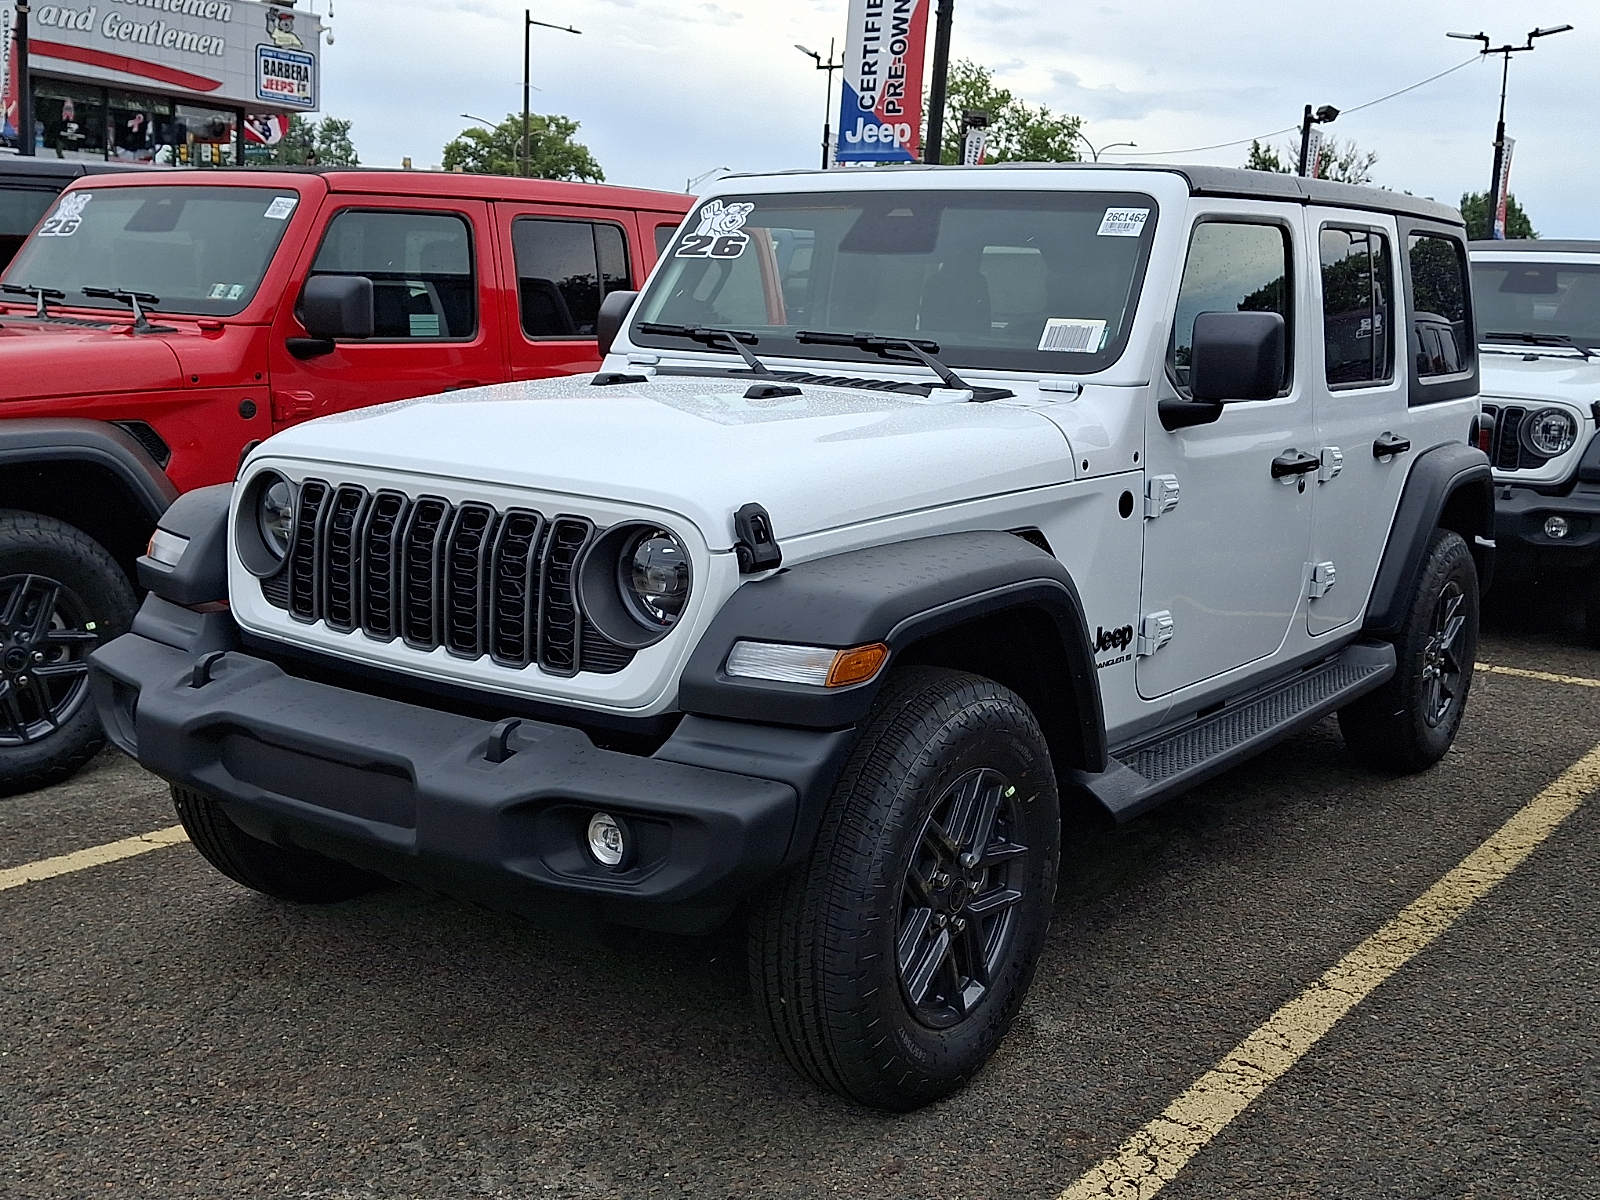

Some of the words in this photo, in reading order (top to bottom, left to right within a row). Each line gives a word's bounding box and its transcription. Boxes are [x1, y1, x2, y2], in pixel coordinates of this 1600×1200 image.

[37, 4, 97, 32] and
[102, 11, 226, 56] Gentlemen
[263, 59, 309, 82] BARBERA
[263, 78, 294, 93] JEEPS
[845, 117, 911, 148] Jeep
[39, 218, 81, 235] 26
[1106, 212, 1147, 222] 26C1462
[676, 235, 748, 256] 26
[1093, 624, 1133, 654] Jeep
